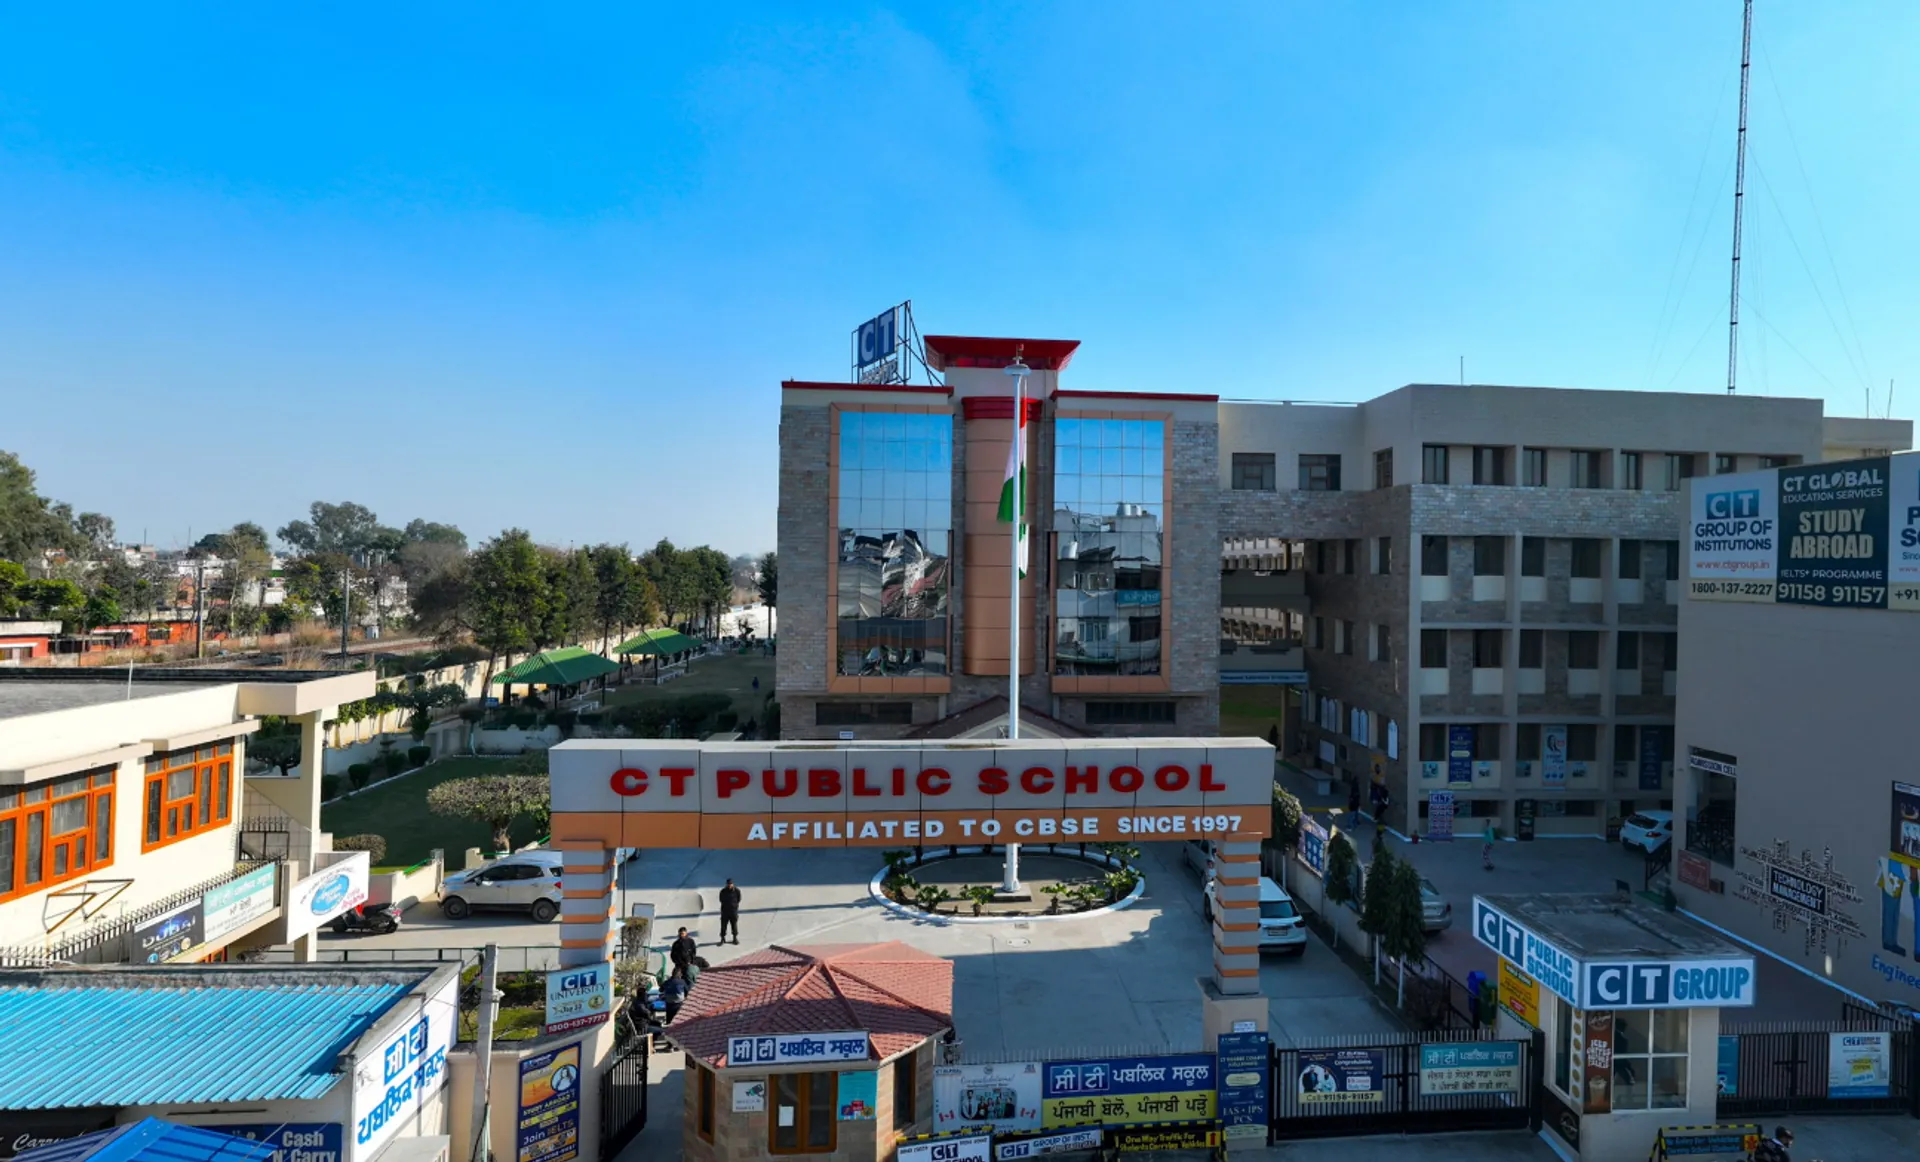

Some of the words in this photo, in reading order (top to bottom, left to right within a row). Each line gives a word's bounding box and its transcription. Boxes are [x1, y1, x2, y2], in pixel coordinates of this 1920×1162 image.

[860, 311, 894, 363] CT
[1783, 476, 1804, 492] CT
[1809, 469, 1883, 489] GLOBAL
[1708, 491, 1757, 518] CT
[1783, 492, 1834, 504] EDUCATION
[1836, 488, 1883, 500] SERVICES
[1695, 521, 1747, 537] GROUP
[1750, 520, 1772, 536] OF
[1799, 508, 1865, 533] STUDY
[1694, 539, 1772, 552] INSTITUTIONS
[1790, 534, 1874, 559] ABROAD
[1697, 560, 1770, 573] www.ctgroup.in
[1812, 569, 1883, 580] PROGRAMME
[1778, 583, 1826, 601] 91158
[1832, 586, 1886, 604] 91157
[610, 767, 695, 797] CT
[716, 763, 951, 798] PUBLIC
[978, 765, 1226, 795] SCHOOL
[1723, 764, 1737, 775] CELL
[747, 820, 945, 840] AFFILIATED
[959, 819, 1002, 836] TO
[1015, 817, 1099, 836] CBSE
[1117, 815, 1186, 834] SINCE
[1191, 815, 1242, 832] 1997
[1773, 870, 1824, 898] TECHNOLOGY
[1481, 908, 1522, 961] CT
[1527, 934, 1572, 978] PUBLIC
[563, 972, 595, 989] CT
[1527, 955, 1575, 1003] SCHOOL
[1594, 966, 1666, 1003] CT
[1673, 967, 1749, 1000] GROUP
[550, 982, 606, 1001] UNIVERSITY
[385, 1038, 405, 1081] ਸੀ
[409, 1019, 428, 1058] ਟੀ
[735, 1040, 751, 1059] ਸੀ
[759, 1039, 774, 1058] ਟੀ
[780, 1038, 825, 1056] ਪਬਲਿਕ
[829, 1039, 865, 1058] ਸਕੂਲ
[1055, 1069, 1075, 1089] ਸੀ
[1085, 1067, 1105, 1089] ਟੀ
[1112, 1063, 1166, 1083] ਪਬਲਿਕ
[1172, 1065, 1209, 1087] ਸਕੂਲ
[357, 1075, 413, 1145] ਪਬਲਿਕ
[413, 1044, 447, 1088] ਸਕੂਲ
[1053, 1100, 1096, 1119] ਪੰਜਾਬੀ
[1102, 1098, 1129, 1118] ਬੋਲੋ,
[1138, 1095, 1180, 1114] ਪੰਜਾਬੀ
[282, 1130, 324, 1147] Cash
[523, 1131, 545, 1145] Join
[1002, 1144, 1028, 1157] CT
[1034, 1137, 1060, 1148] GROUP
[1062, 1136, 1070, 1144] OF
[1125, 1136, 1141, 1144] One
[933, 1144, 957, 1160] CT
